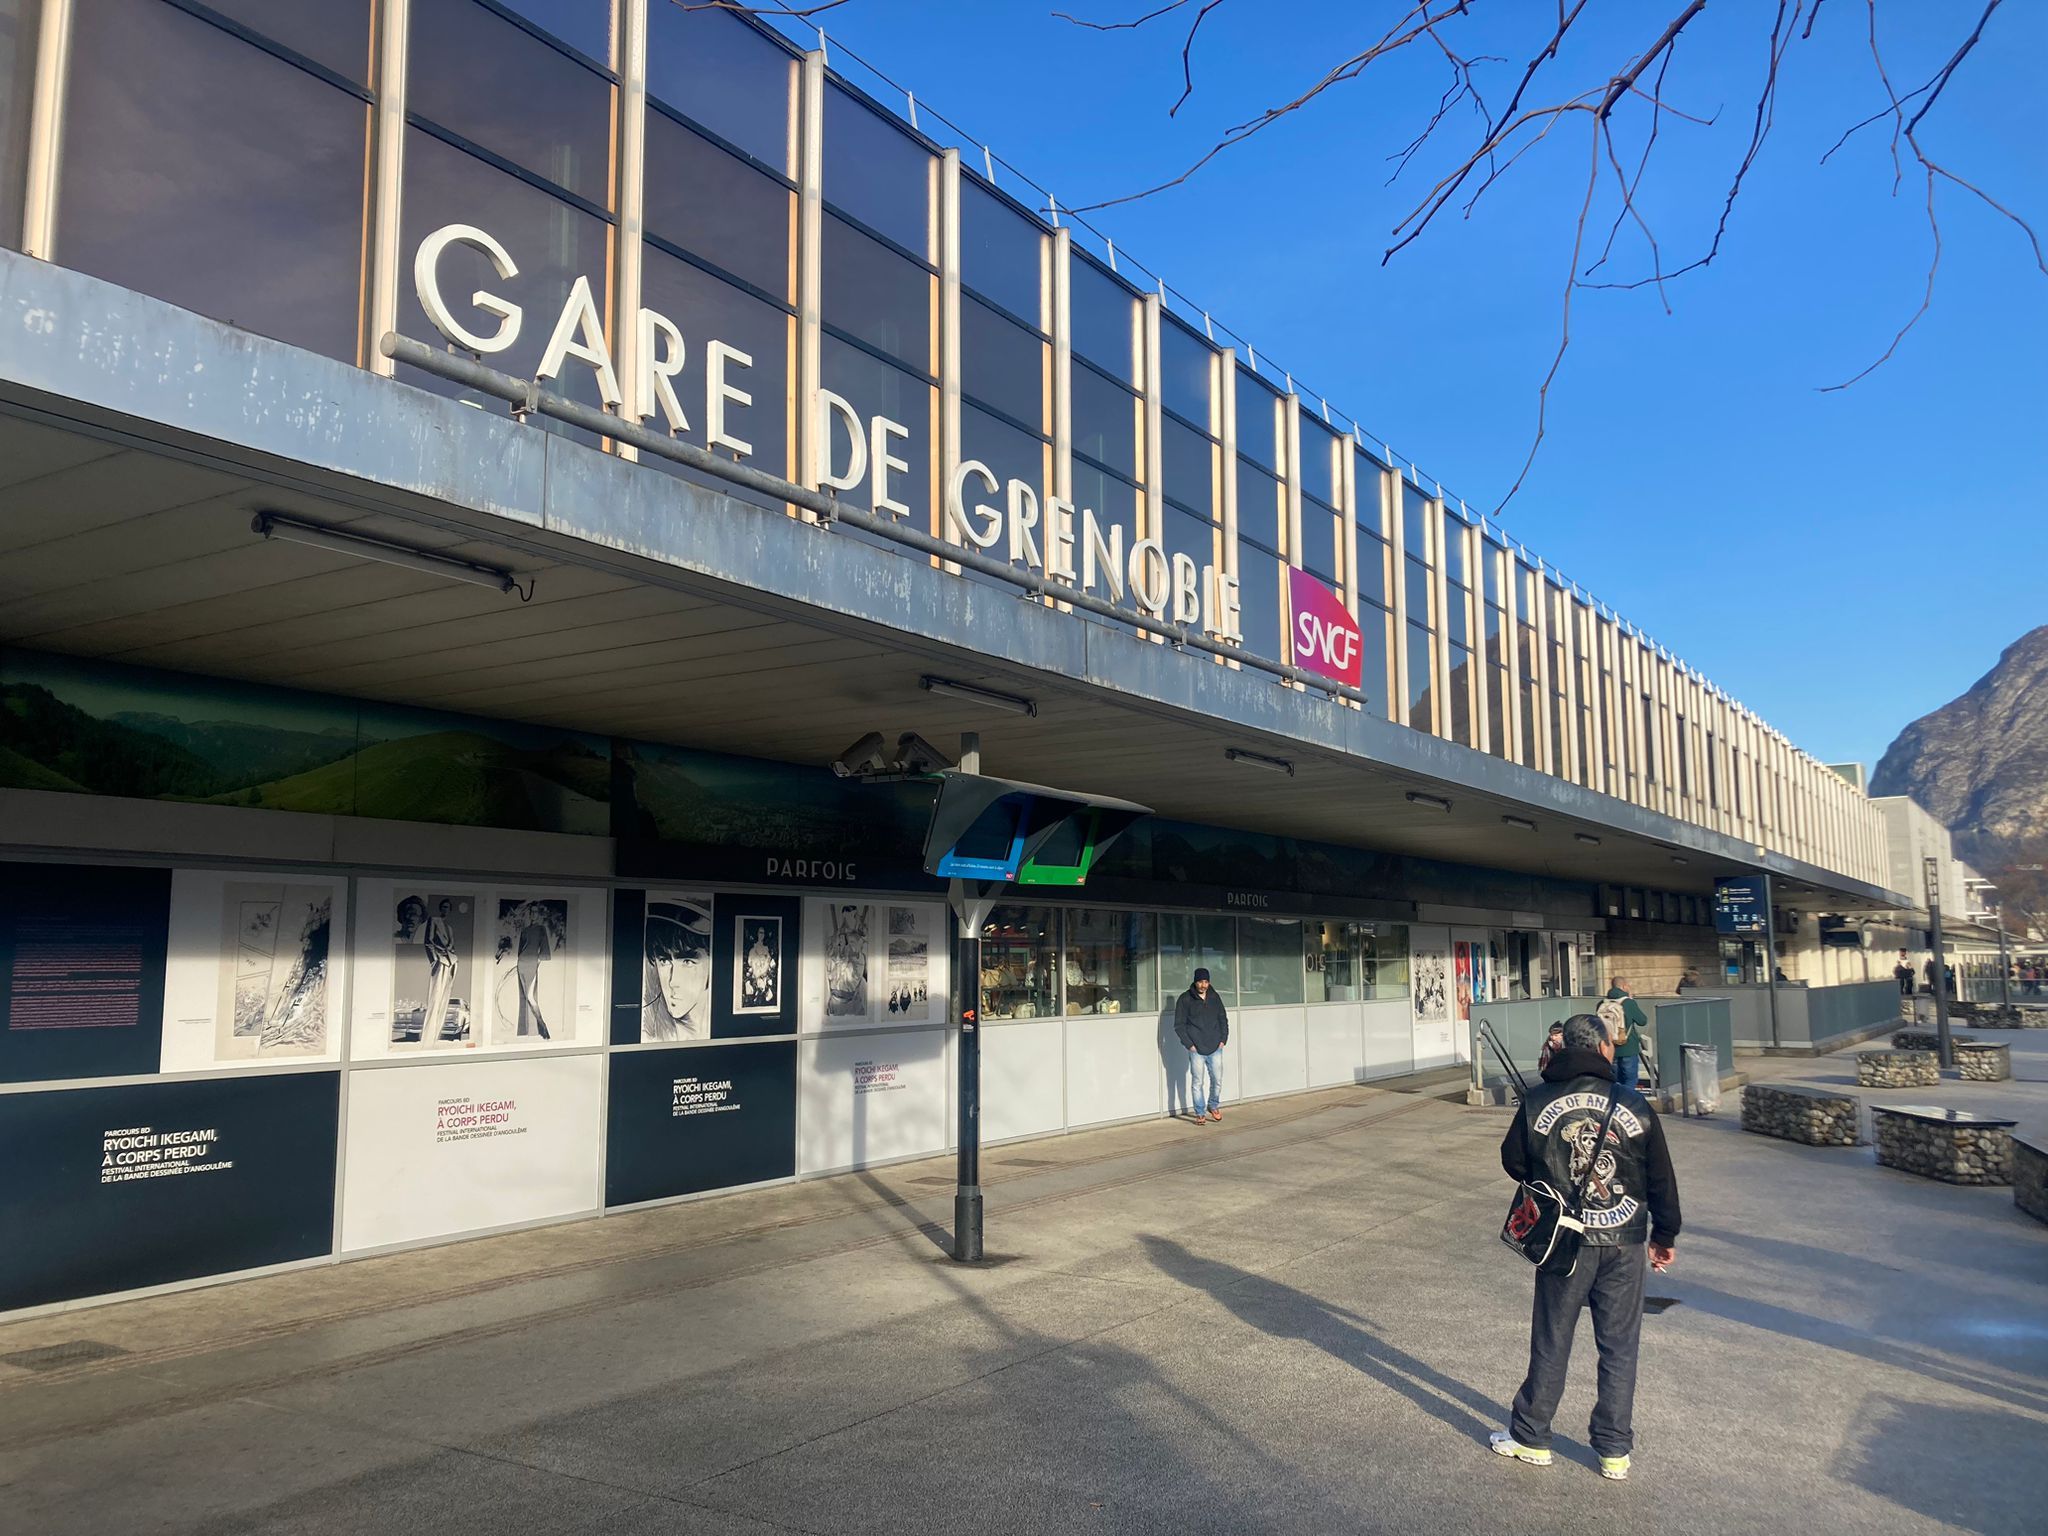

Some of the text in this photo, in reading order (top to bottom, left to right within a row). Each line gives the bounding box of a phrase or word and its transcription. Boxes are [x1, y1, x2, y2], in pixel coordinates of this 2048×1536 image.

[415, 224, 1243, 643] GARE DE GRENOBLE
[1297, 611, 1359, 670] SNCF
[767, 857, 856, 880] PARFOIS
[1227, 892, 1268, 907] PARFOIS
[673, 1083, 702, 1094] RYOICHI
[680, 1093, 703, 1104] CORPS
[704, 1091, 727, 1102] PERDU
[438, 1100, 516, 1116] RYOICHI IKEGAMI,
[1539, 1096, 1640, 1134] SONS OF ANRCHY
[446, 1116, 478, 1128] CORPS
[480, 1113, 509, 1124] PERDU
[103, 1129, 218, 1152] RYOICHI IKEGAMI,
[104, 1128, 140, 1138] PARCOURS
[101, 1144, 207, 1167] À CORPS PERDU
[101, 1161, 233, 1184] DE LA BANDE DESSINÉE D'ANGOULÊME
[102, 1160, 190, 1176] FESTIVAL INTERNATIONAL
